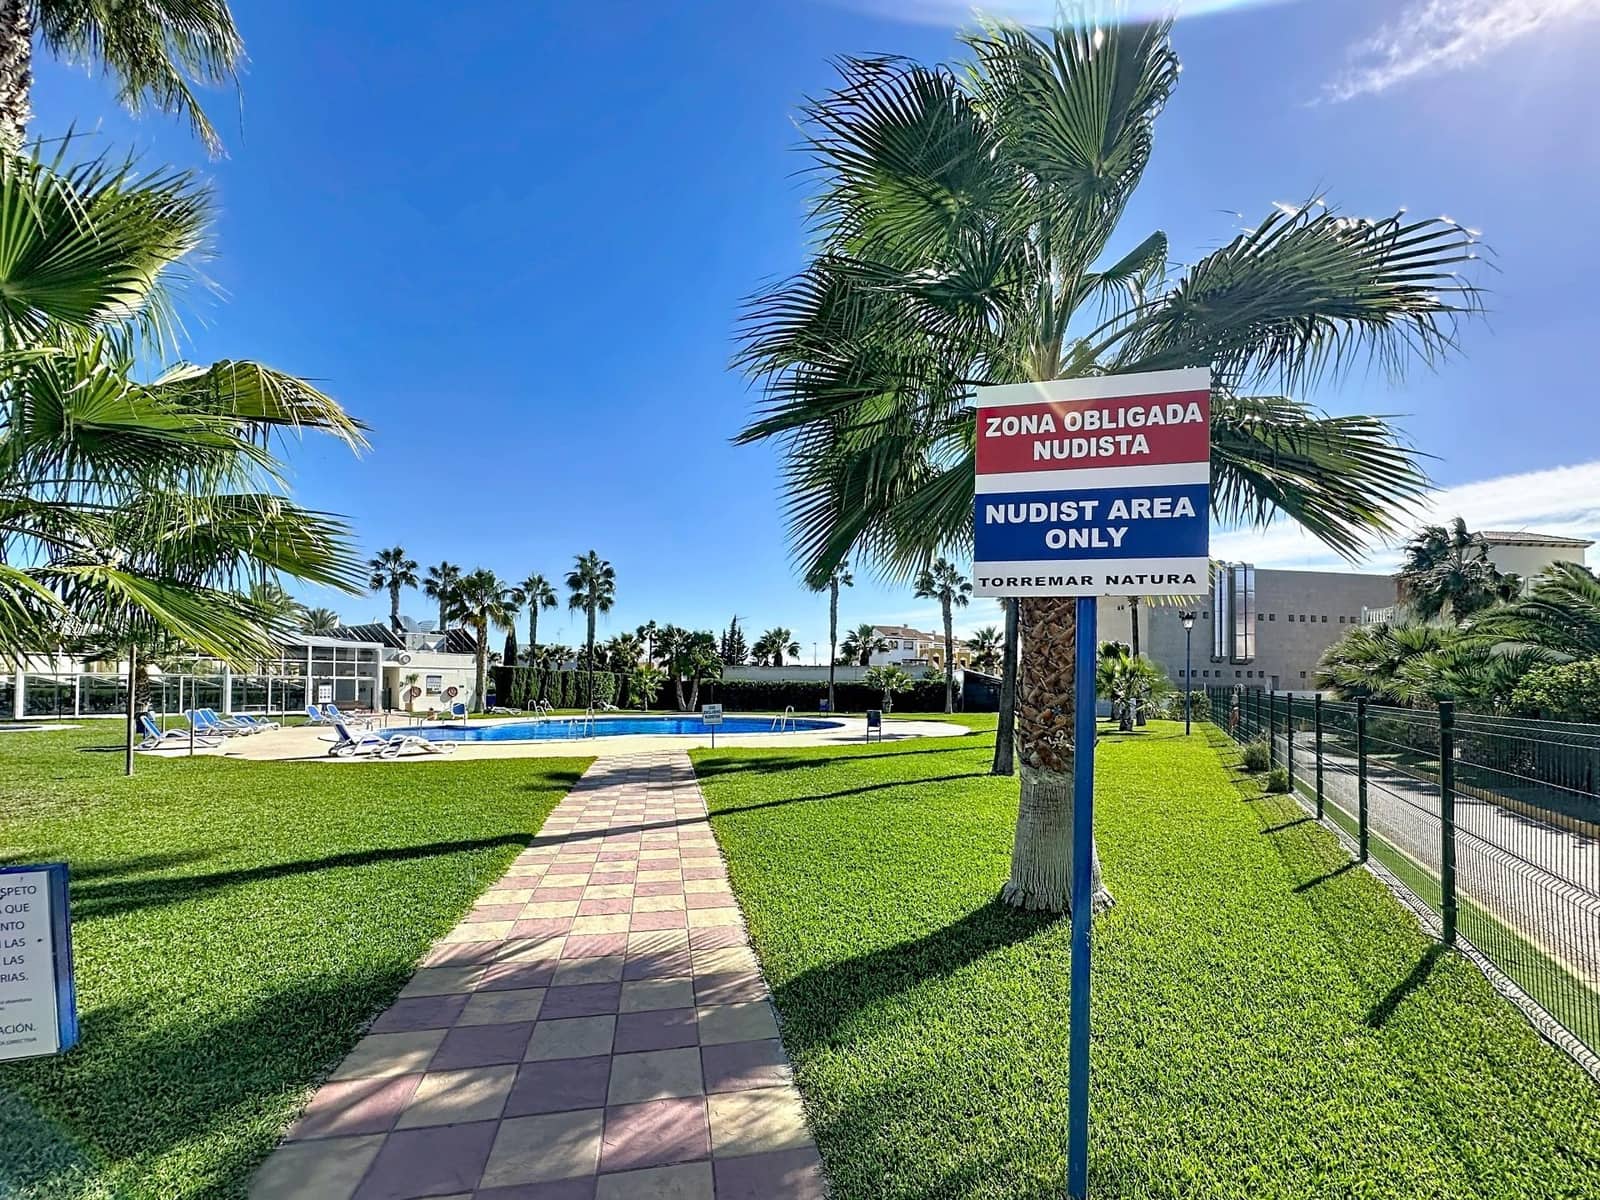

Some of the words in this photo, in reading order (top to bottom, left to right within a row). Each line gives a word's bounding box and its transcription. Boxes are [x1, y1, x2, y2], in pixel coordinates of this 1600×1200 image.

[985, 414, 1056, 438] ZONA
[1064, 402, 1203, 432] OBLIGADA
[1033, 434, 1150, 461] NUDISTA
[986, 500, 1099, 524] NUDIST
[1108, 496, 1196, 520] AREA
[1045, 527, 1128, 549] ONLY
[979, 575, 1093, 587] TORREMAR
[1105, 574, 1197, 585] NATURA
[4, 903, 30, 914] QUE
[4, 938, 26, 949] LAS
[3, 955, 24, 966] LAS
